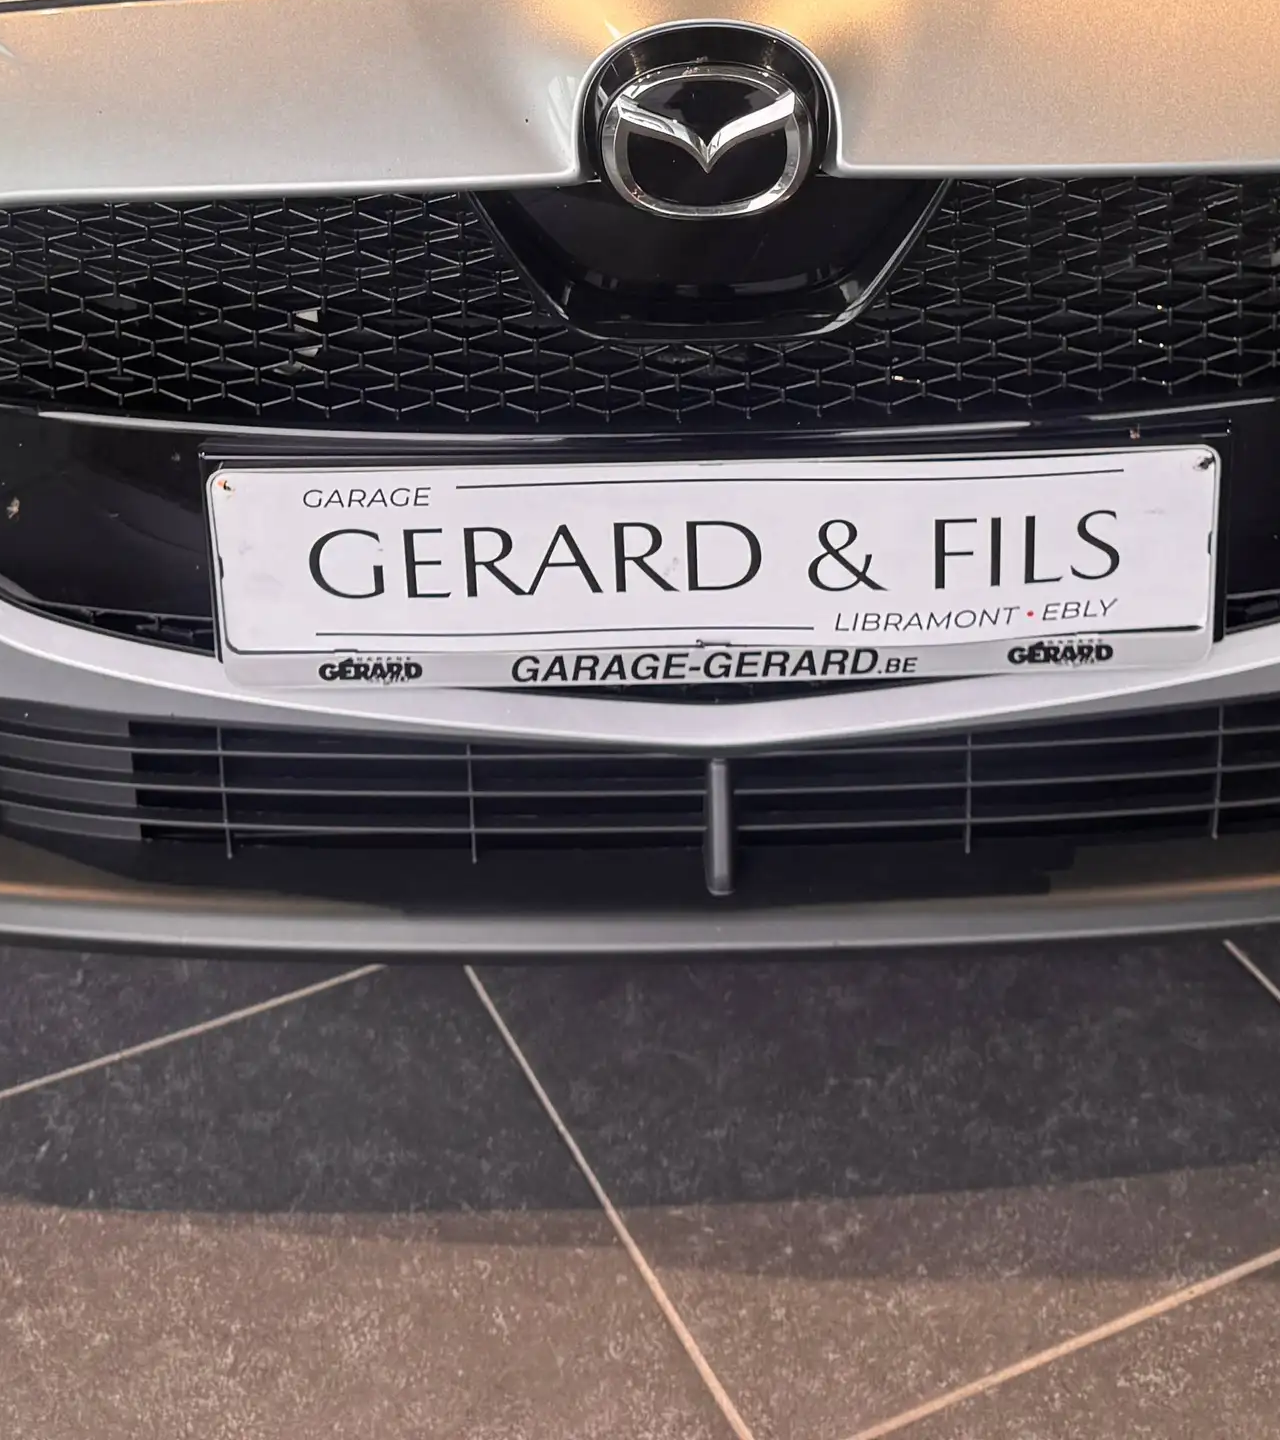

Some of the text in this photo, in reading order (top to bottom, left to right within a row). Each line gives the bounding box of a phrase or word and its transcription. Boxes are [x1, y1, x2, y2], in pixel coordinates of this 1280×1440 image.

[302, 487, 432, 509] GARAGE
[308, 510, 1120, 599] GERARD & FILS
[835, 598, 1118, 633] LIBRAMONT EBLY
